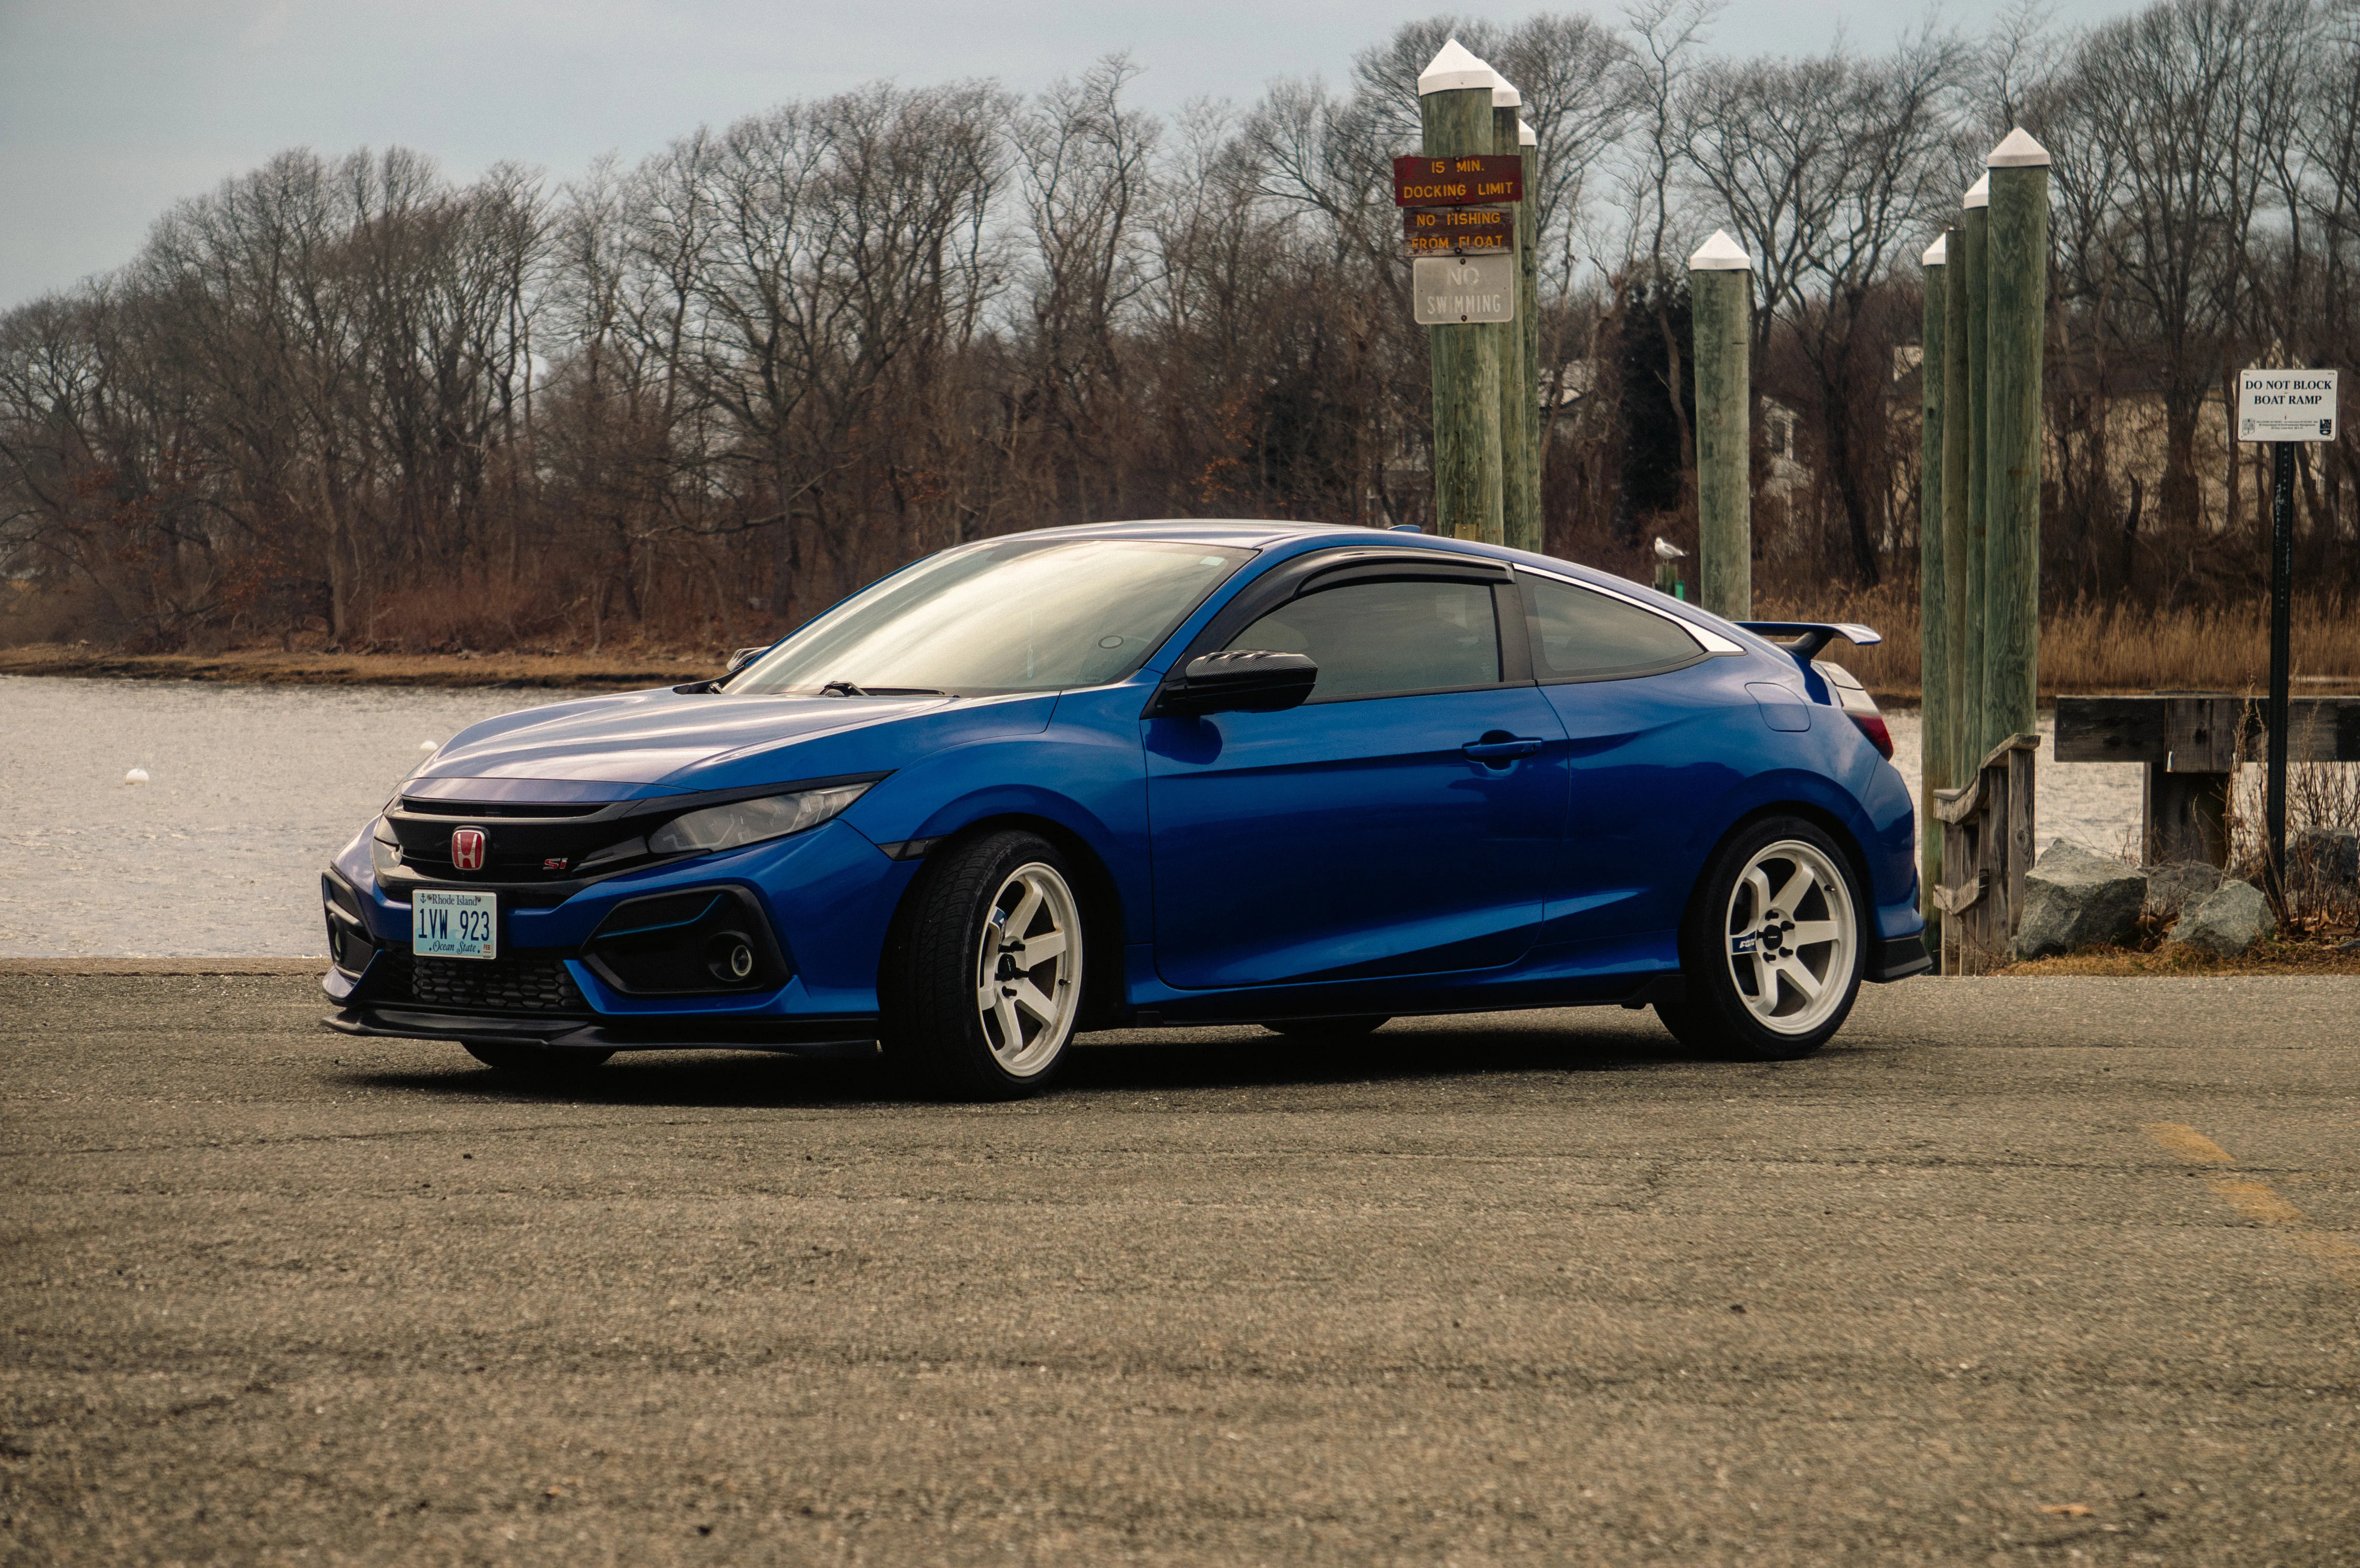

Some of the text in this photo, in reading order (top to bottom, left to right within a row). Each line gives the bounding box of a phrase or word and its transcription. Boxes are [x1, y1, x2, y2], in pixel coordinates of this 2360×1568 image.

[1432, 160, 1485, 173] 15 MIN.
[1403, 182, 1513, 198] DOCKING LIMIT
[1416, 212, 1500, 226] NO FISHING
[1412, 235, 1503, 249] FROM FLOAT
[1447, 267, 1480, 285] NO
[1427, 294, 1500, 315] SWIMMING
[2245, 380, 2332, 390] DO NOT BLOCK
[2254, 395, 2322, 404] BOAT RAMP
[543, 858, 568, 870] Si
[432, 894, 478, 906] Rhode Island
[418, 908, 490, 942] 1VW 923
[433, 940, 477, 954] Ocean State
